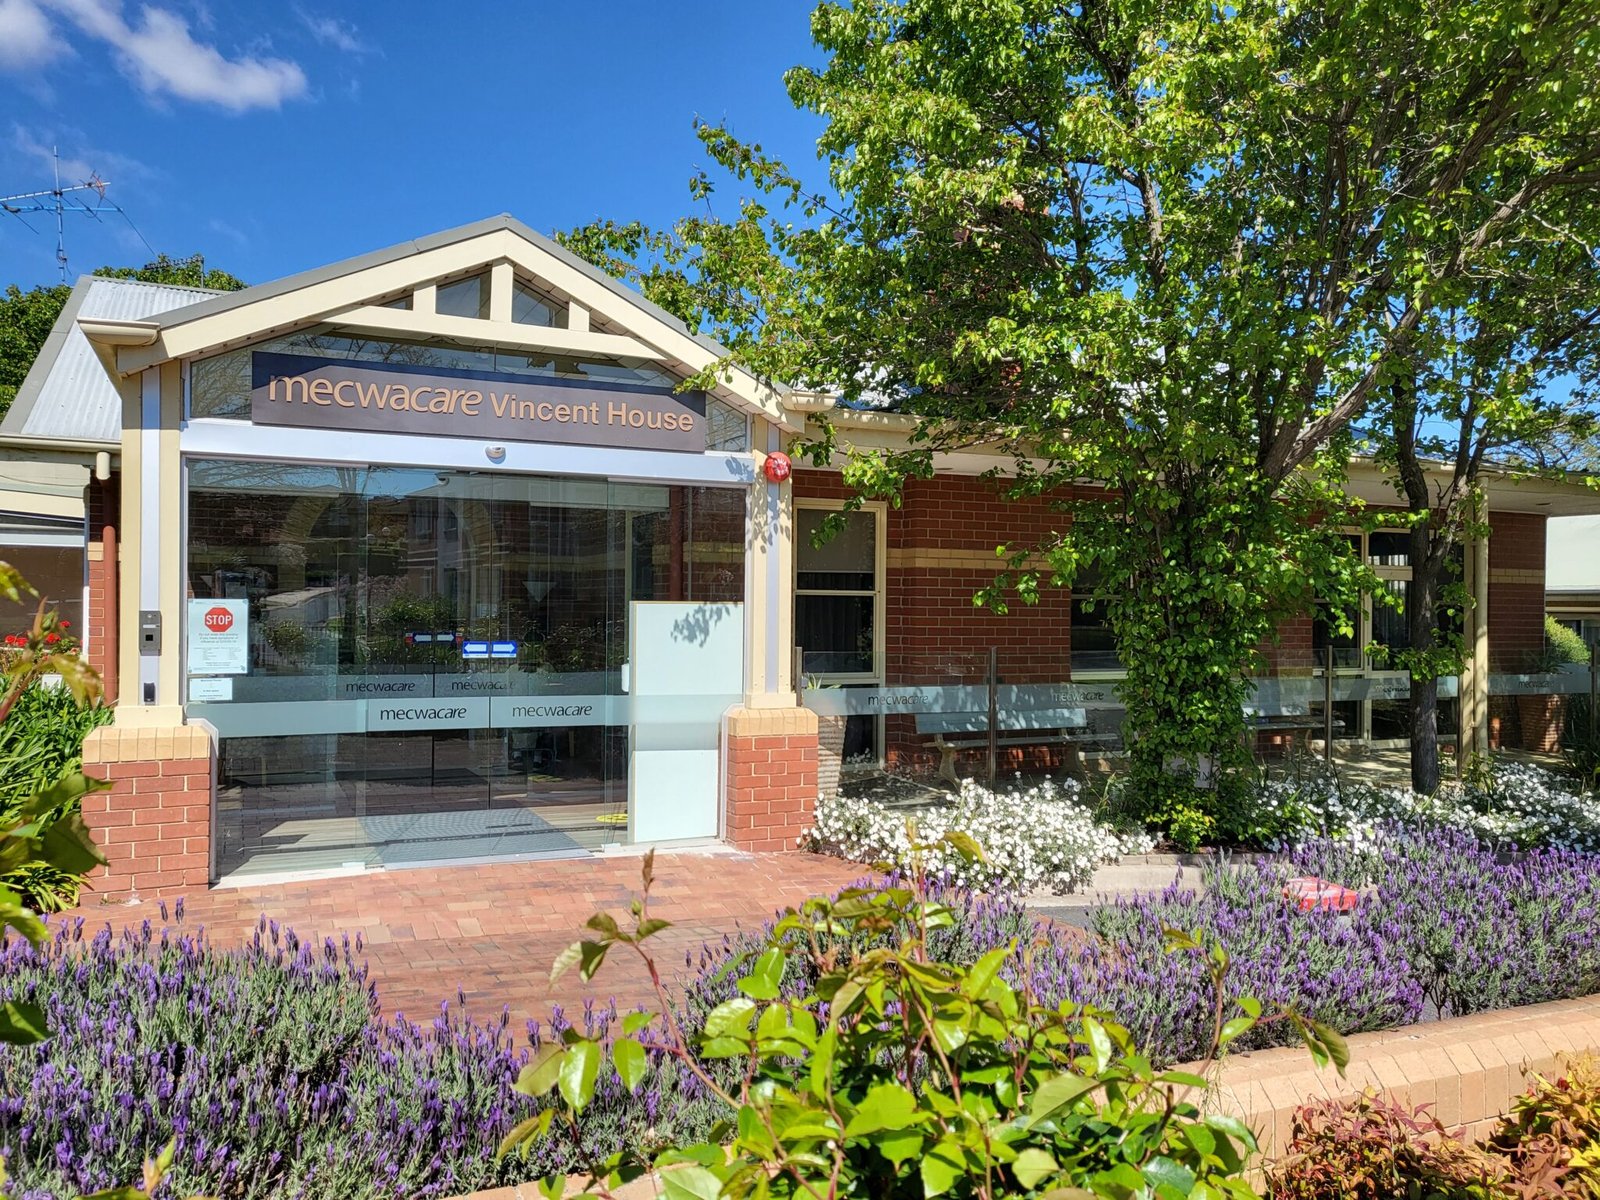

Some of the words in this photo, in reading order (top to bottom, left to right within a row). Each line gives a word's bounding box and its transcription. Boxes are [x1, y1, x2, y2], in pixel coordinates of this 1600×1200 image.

[269, 375, 483, 416] mecwacare
[490, 392, 599, 425] Vincent
[607, 402, 694, 432] House
[206, 615, 232, 625] STOP
[346, 681, 415, 693] mecwacare
[868, 694, 928, 705] mecwacare
[380, 707, 467, 720] mecwacare
[512, 704, 592, 717] mecwacare
